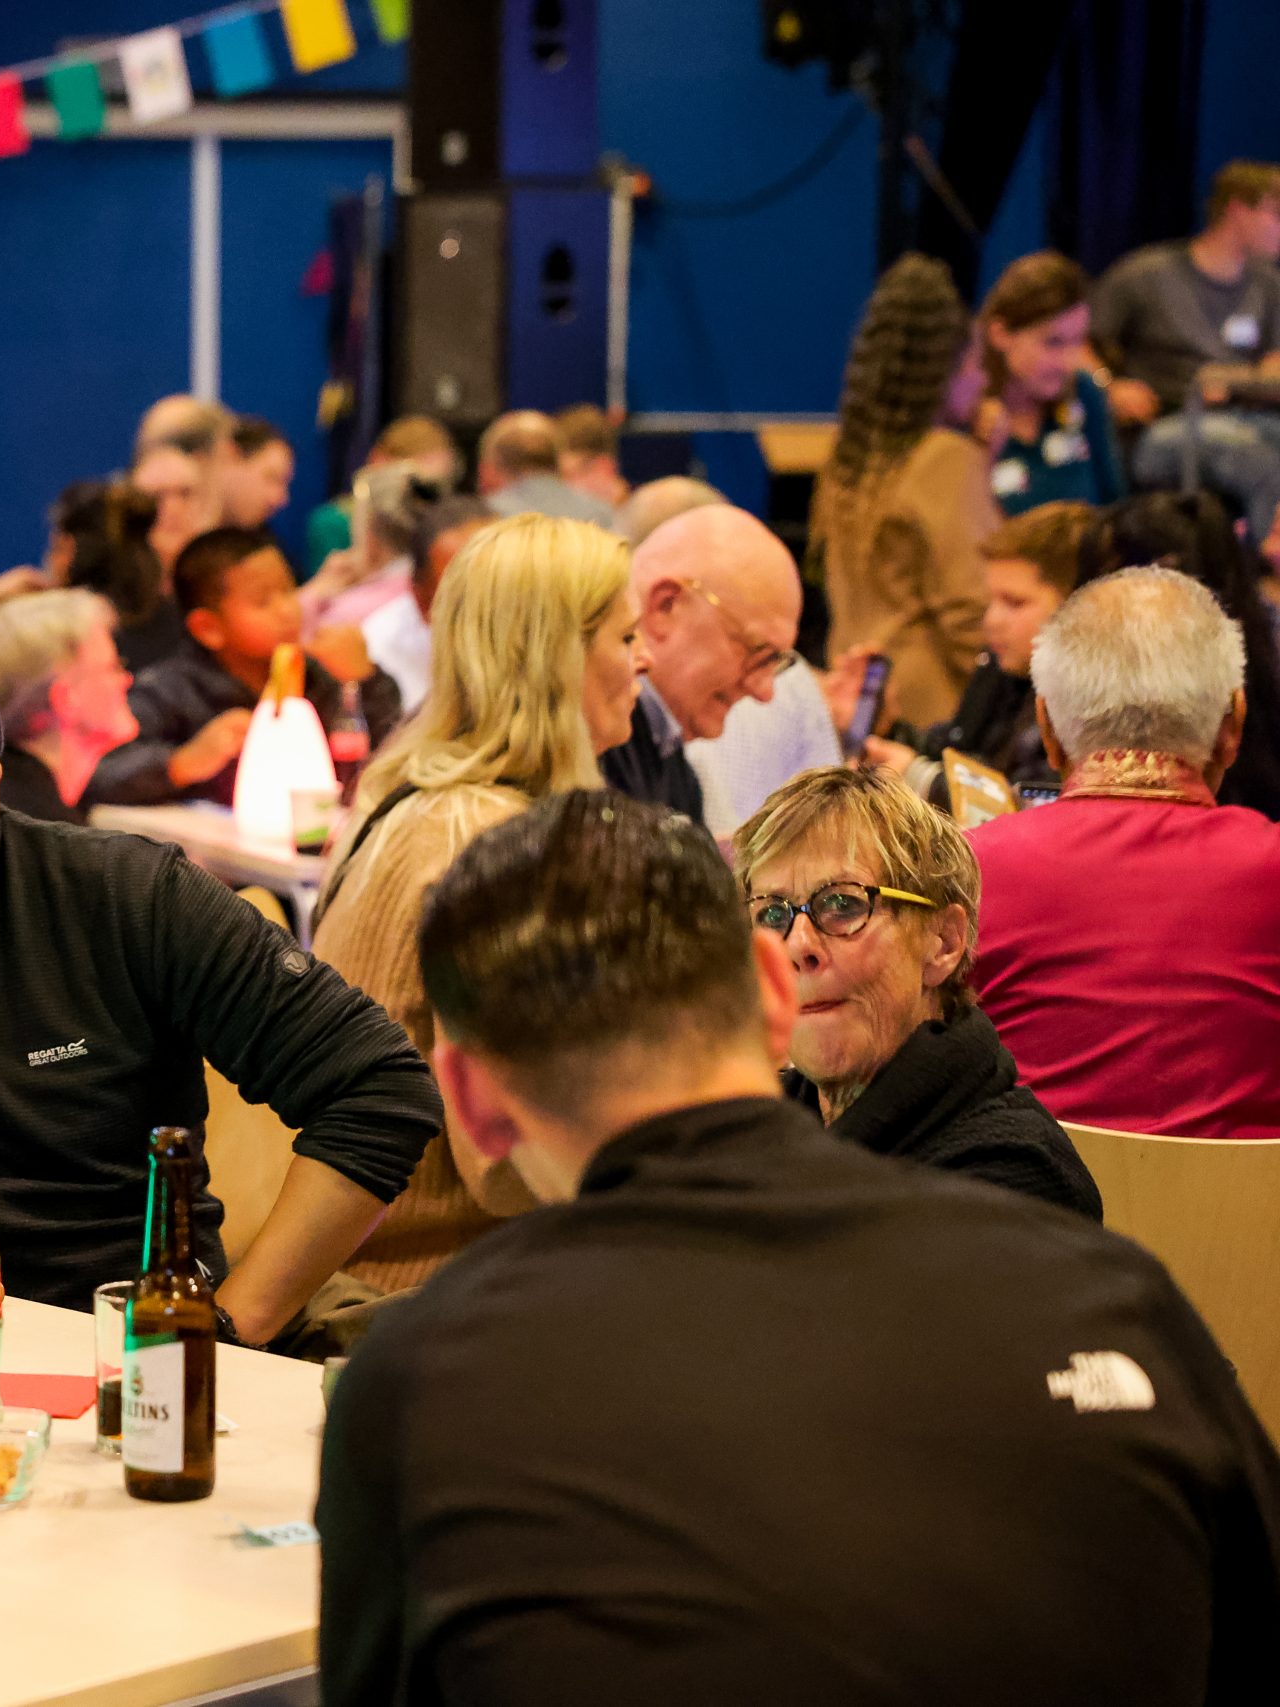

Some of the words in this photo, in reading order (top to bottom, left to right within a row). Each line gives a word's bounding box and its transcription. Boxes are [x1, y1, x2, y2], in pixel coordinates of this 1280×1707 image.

[27, 1046, 67, 1061] REGATTA
[29, 1056, 50, 1067] GREAT
[50, 1047, 88, 1063] OUTDOORS
